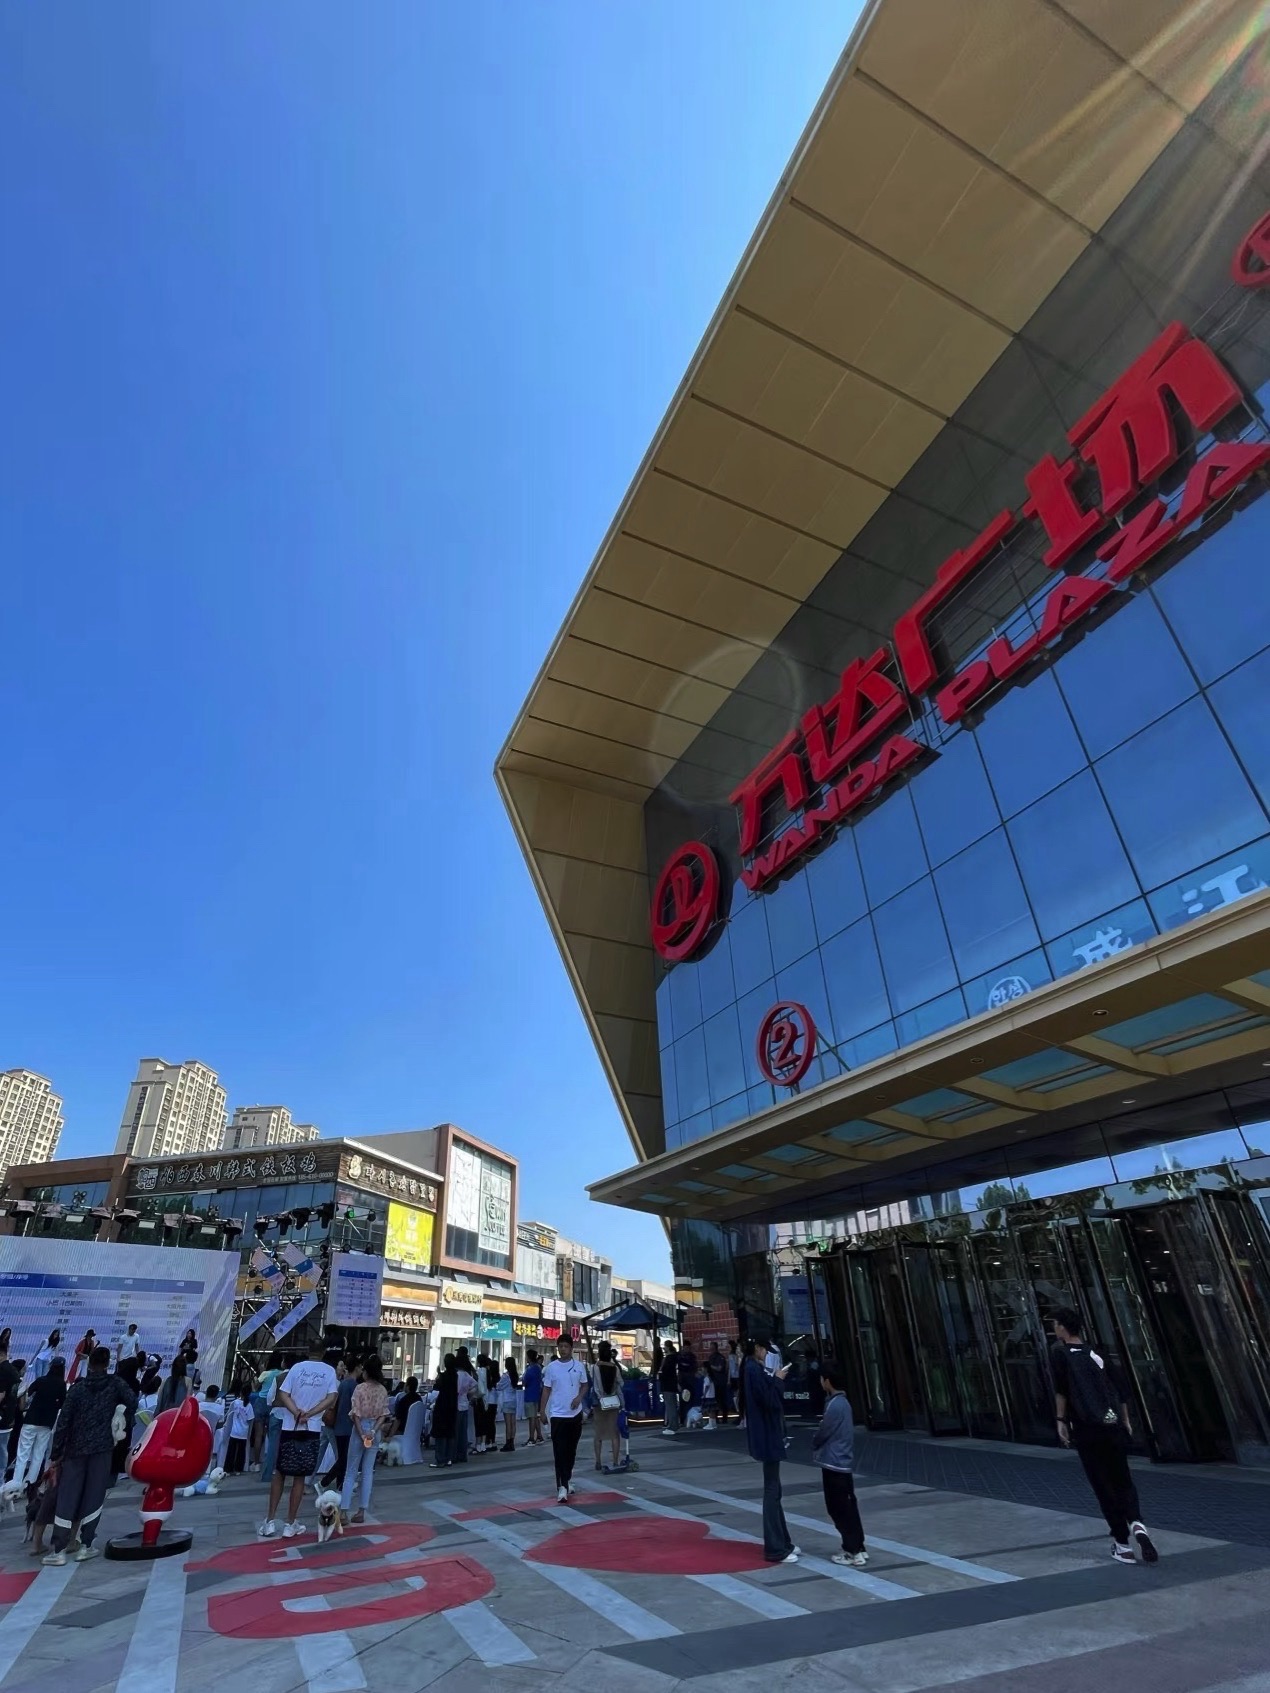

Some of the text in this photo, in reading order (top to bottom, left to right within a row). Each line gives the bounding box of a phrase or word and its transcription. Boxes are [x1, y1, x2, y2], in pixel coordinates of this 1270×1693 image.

[729, 321, 1244, 857] 万达广场
[740, 442, 1270, 891] WANDA PLAZA
[770, 1020, 801, 1069] 2
